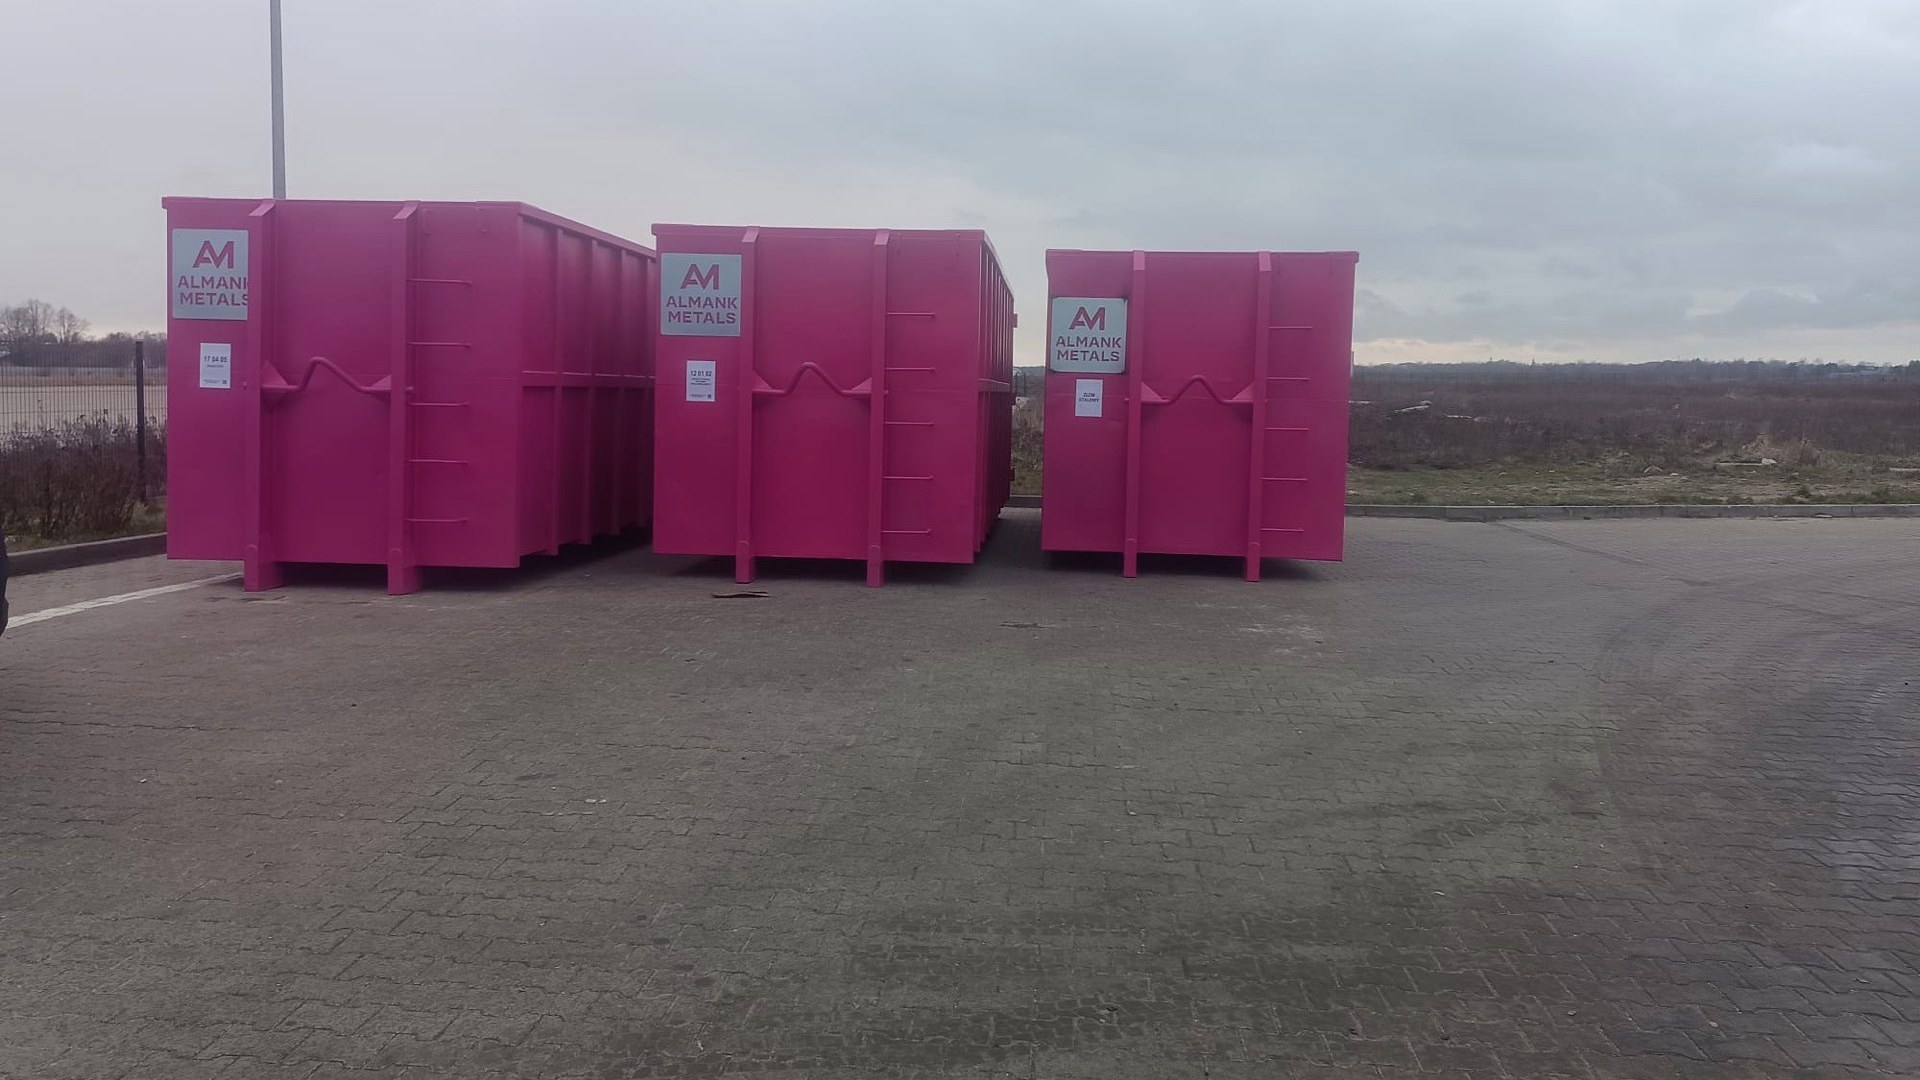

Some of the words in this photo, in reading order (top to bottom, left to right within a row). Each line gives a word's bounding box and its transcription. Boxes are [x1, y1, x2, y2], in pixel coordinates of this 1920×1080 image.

[192, 240, 234, 269] AM
[680, 263, 720, 290] AM
[180, 292, 249, 306] METALS
[666, 295, 738, 309] ALMANK
[668, 310, 736, 324] METALS
[1069, 306, 1105, 331] AM
[1055, 336, 1122, 348] ALMANK
[1056, 349, 1120, 362] METALS
